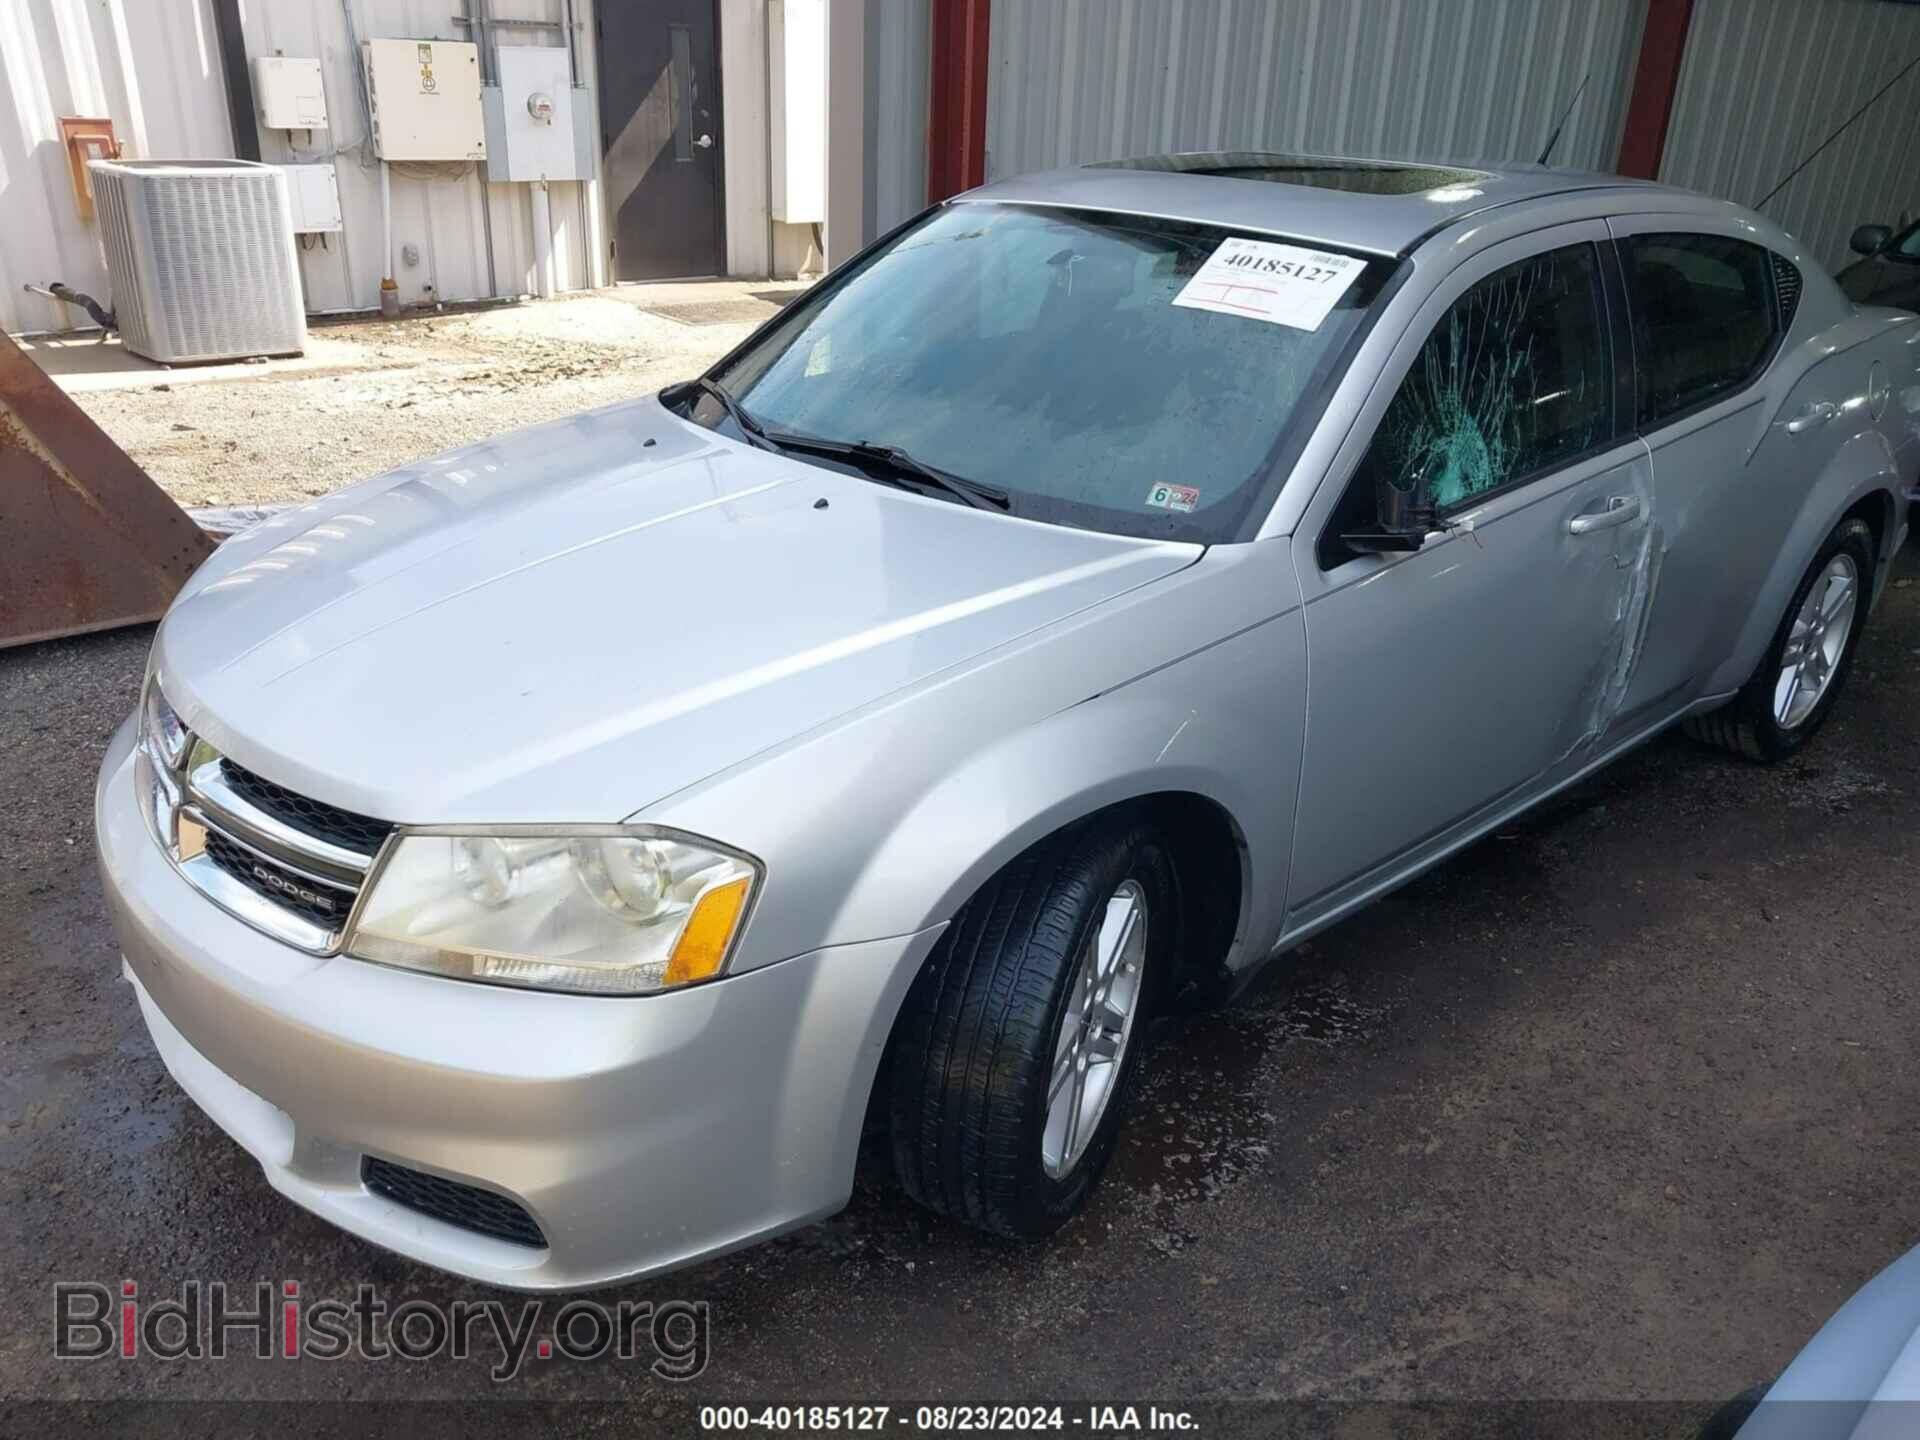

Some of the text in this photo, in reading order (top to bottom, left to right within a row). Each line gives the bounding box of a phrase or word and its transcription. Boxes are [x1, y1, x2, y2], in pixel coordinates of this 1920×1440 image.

[1224, 252, 1338, 285] 40185127
[1155, 488, 1168, 502] 6
[254, 866, 334, 910] DODGE
